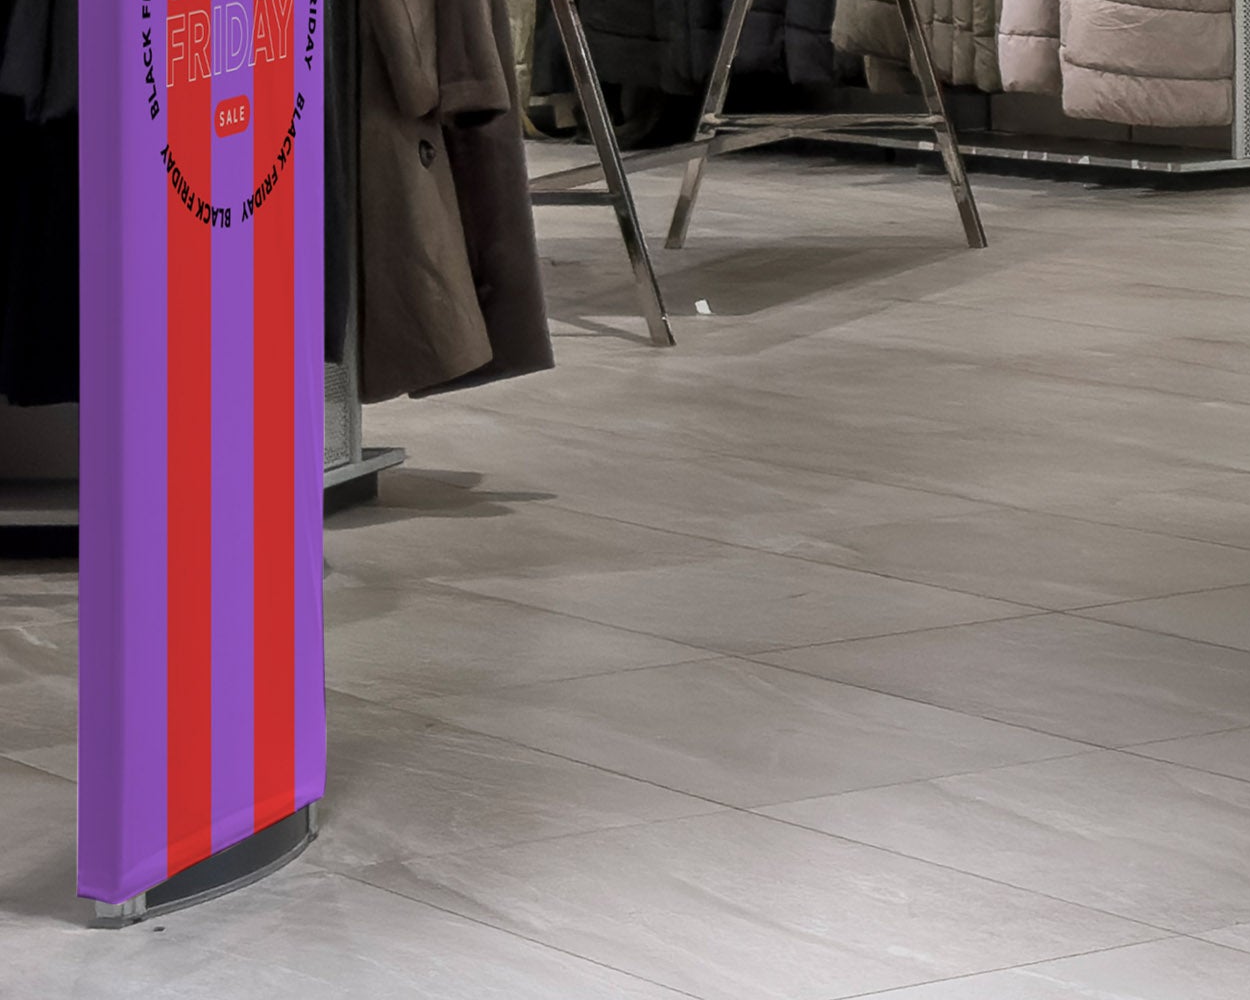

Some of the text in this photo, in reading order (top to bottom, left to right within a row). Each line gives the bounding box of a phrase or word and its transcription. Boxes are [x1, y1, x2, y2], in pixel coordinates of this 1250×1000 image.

[142, 28, 160, 120] BLACK
[219, 105, 245, 127] SALE
[160, 143, 231, 228] BLACK FRIDAY
[241, 92, 305, 222] BLACK FRIDAY
